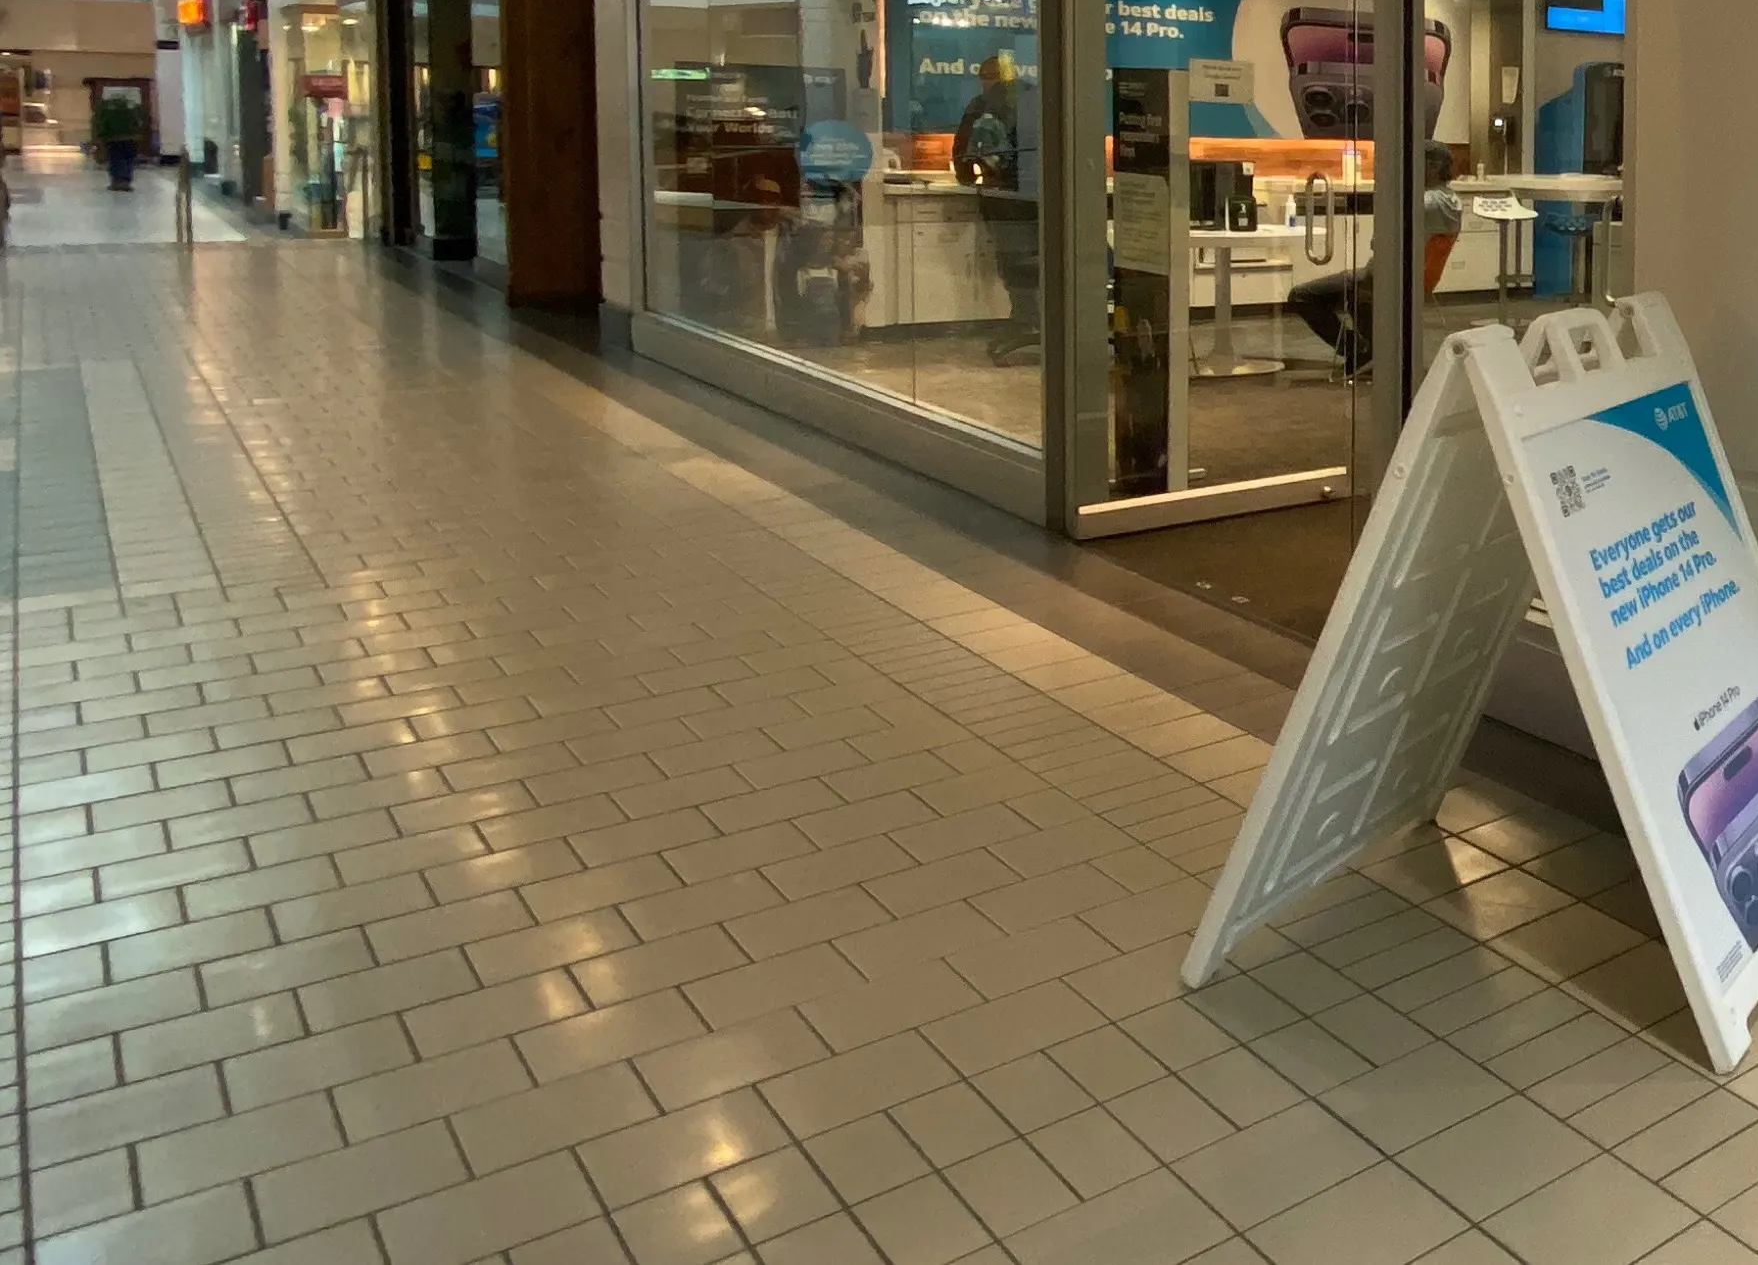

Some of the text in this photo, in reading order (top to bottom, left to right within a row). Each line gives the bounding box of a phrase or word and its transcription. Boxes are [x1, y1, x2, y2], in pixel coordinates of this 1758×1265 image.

[952, 8, 990, 27] the
[1121, 21, 1143, 36] 14
[1146, 22, 1185, 39] Pro.
[1117, 0, 1161, 19] best
[1164, 4, 1215, 22] deals
[919, 57, 966, 76] And
[1668, 402, 1688, 423] AT&T
[1589, 501, 1697, 571] Everyone gets our
[1598, 530, 1700, 599] best deals on the
[1609, 550, 1717, 628] new iPhone 14 Pro.
[1625, 580, 1740, 670] And on every iPhone.
[1698, 701, 1722, 727] iPhone
